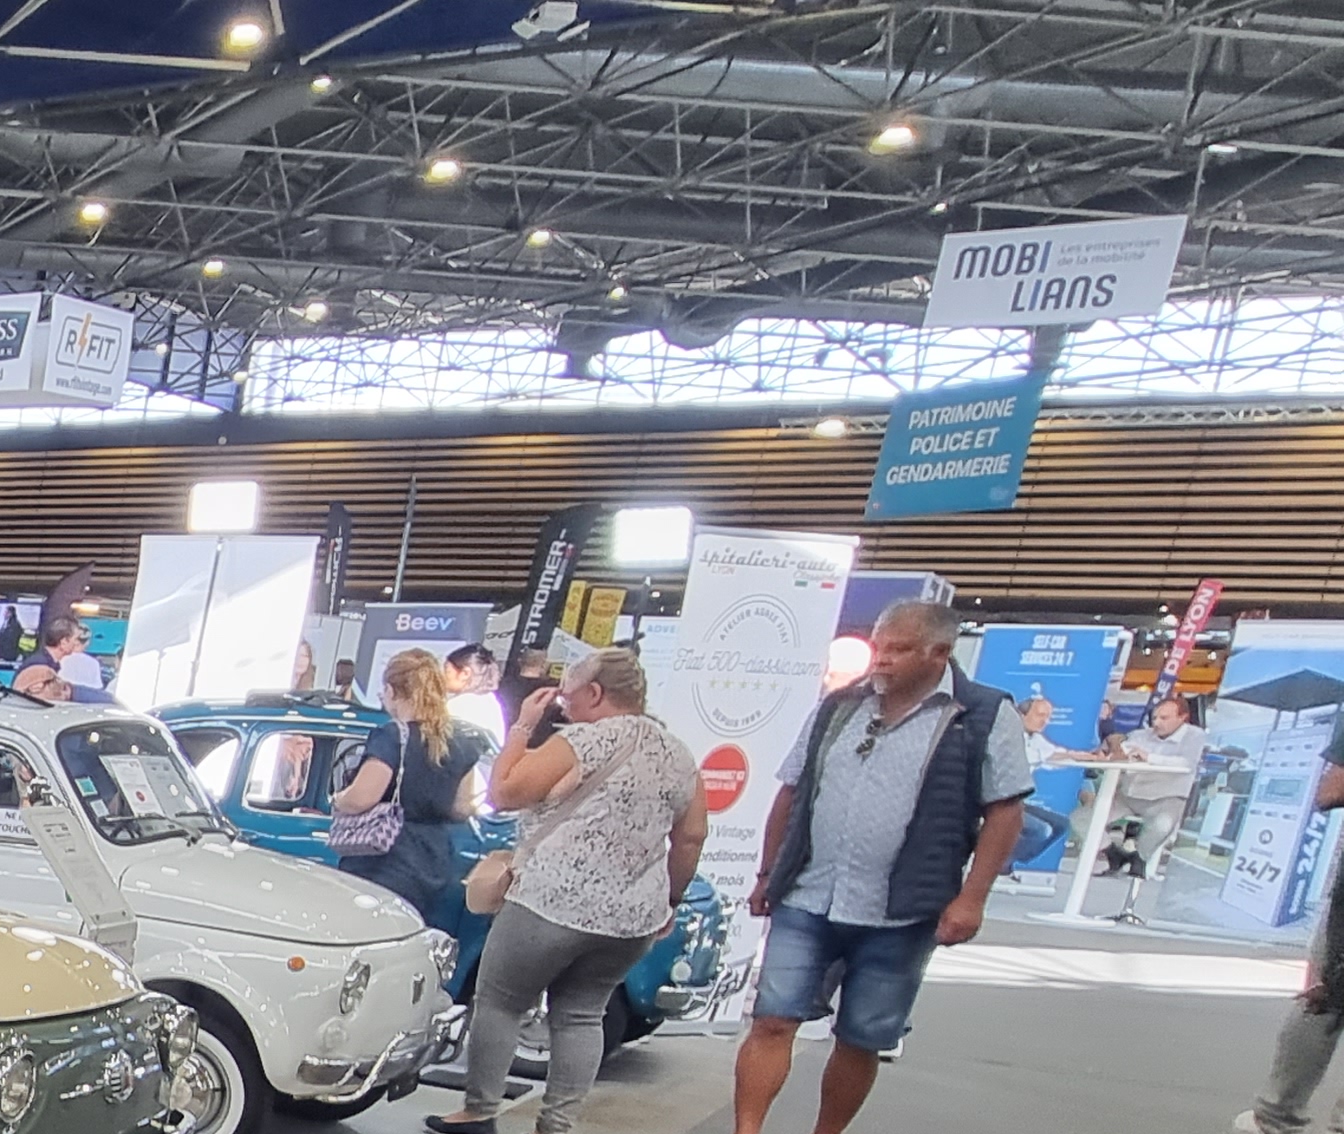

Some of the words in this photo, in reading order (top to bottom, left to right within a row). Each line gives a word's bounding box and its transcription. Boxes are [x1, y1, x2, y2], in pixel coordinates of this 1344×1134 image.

[953, 241, 1053, 280] MOBI
[1010, 274, 1117, 313] LIANS
[908, 396, 1017, 431] PATRIMOINE
[909, 429, 973, 456] POLICE
[975, 427, 1001, 449] ET
[885, 454, 1012, 486] GENDARMERIE
[699, 547, 838, 571] spitalieri-auto
[520, 540, 566, 645] STROMER
[395, 614, 454, 632] Beev
[1178, 587, 1215, 641] LYON
[646, 624, 676, 634] ADVE
[716, 826, 756, 841] Vintage
[700, 849, 758, 863] onditionné
[1235, 856, 1281, 882] 24/7
[716, 873, 745, 885] mois
